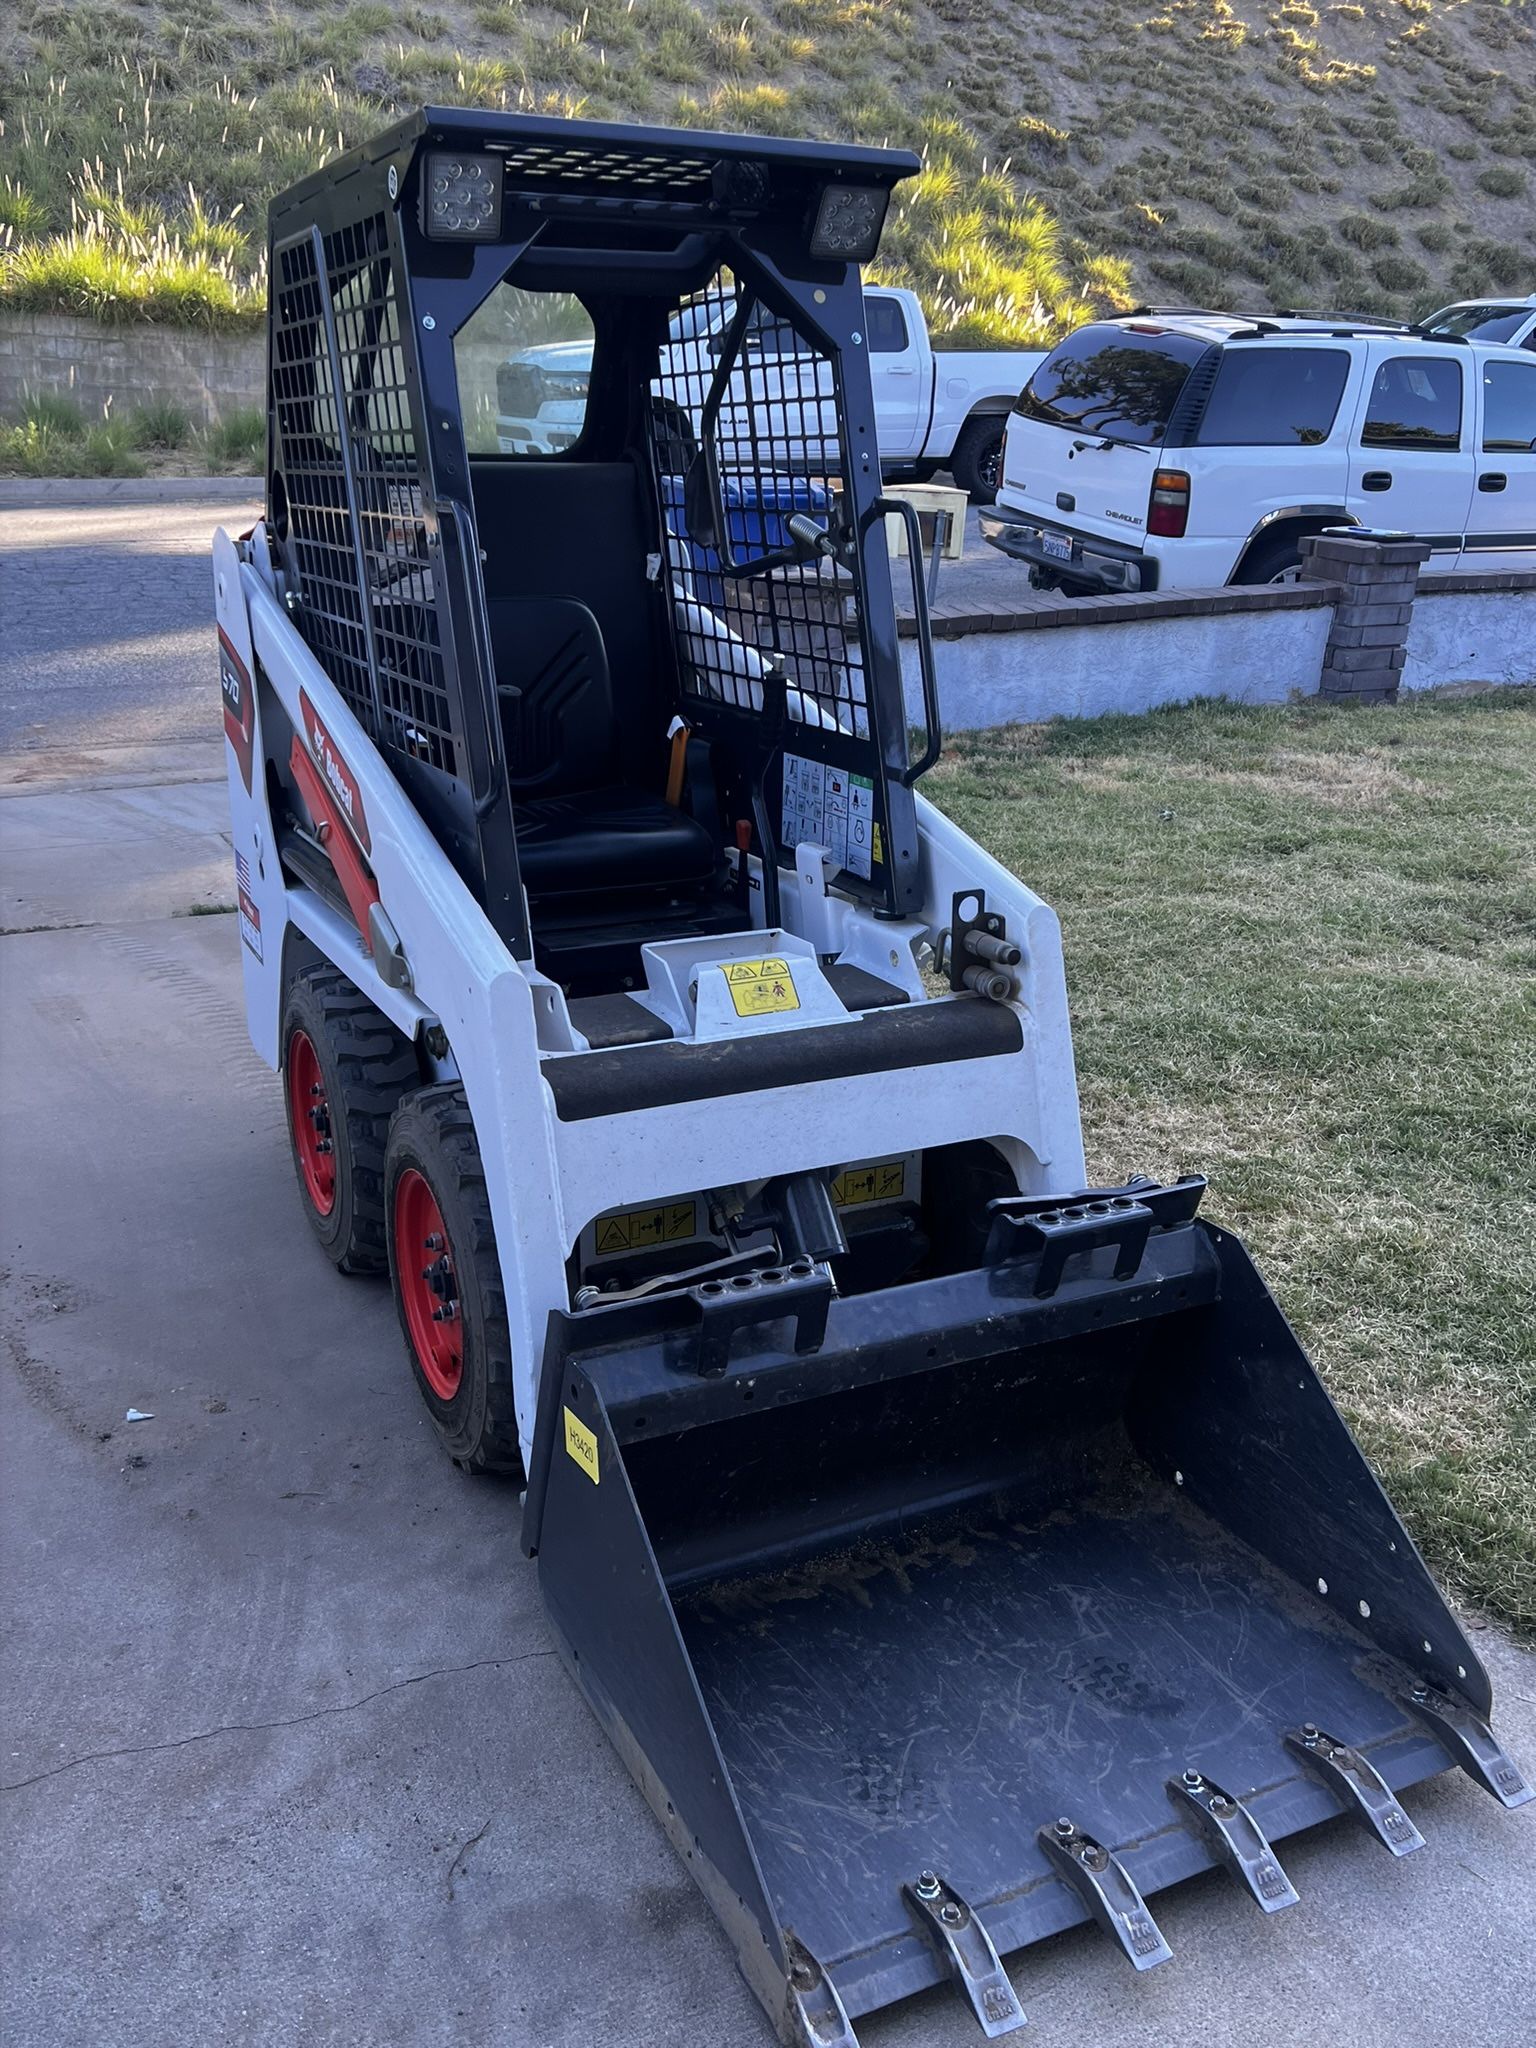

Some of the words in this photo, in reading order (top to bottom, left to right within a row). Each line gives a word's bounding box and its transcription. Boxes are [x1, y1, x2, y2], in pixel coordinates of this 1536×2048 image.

[1105, 509, 1143, 525] CHEVROLET
[222, 666, 239, 705] S70
[326, 747, 353, 817] Bobcat
